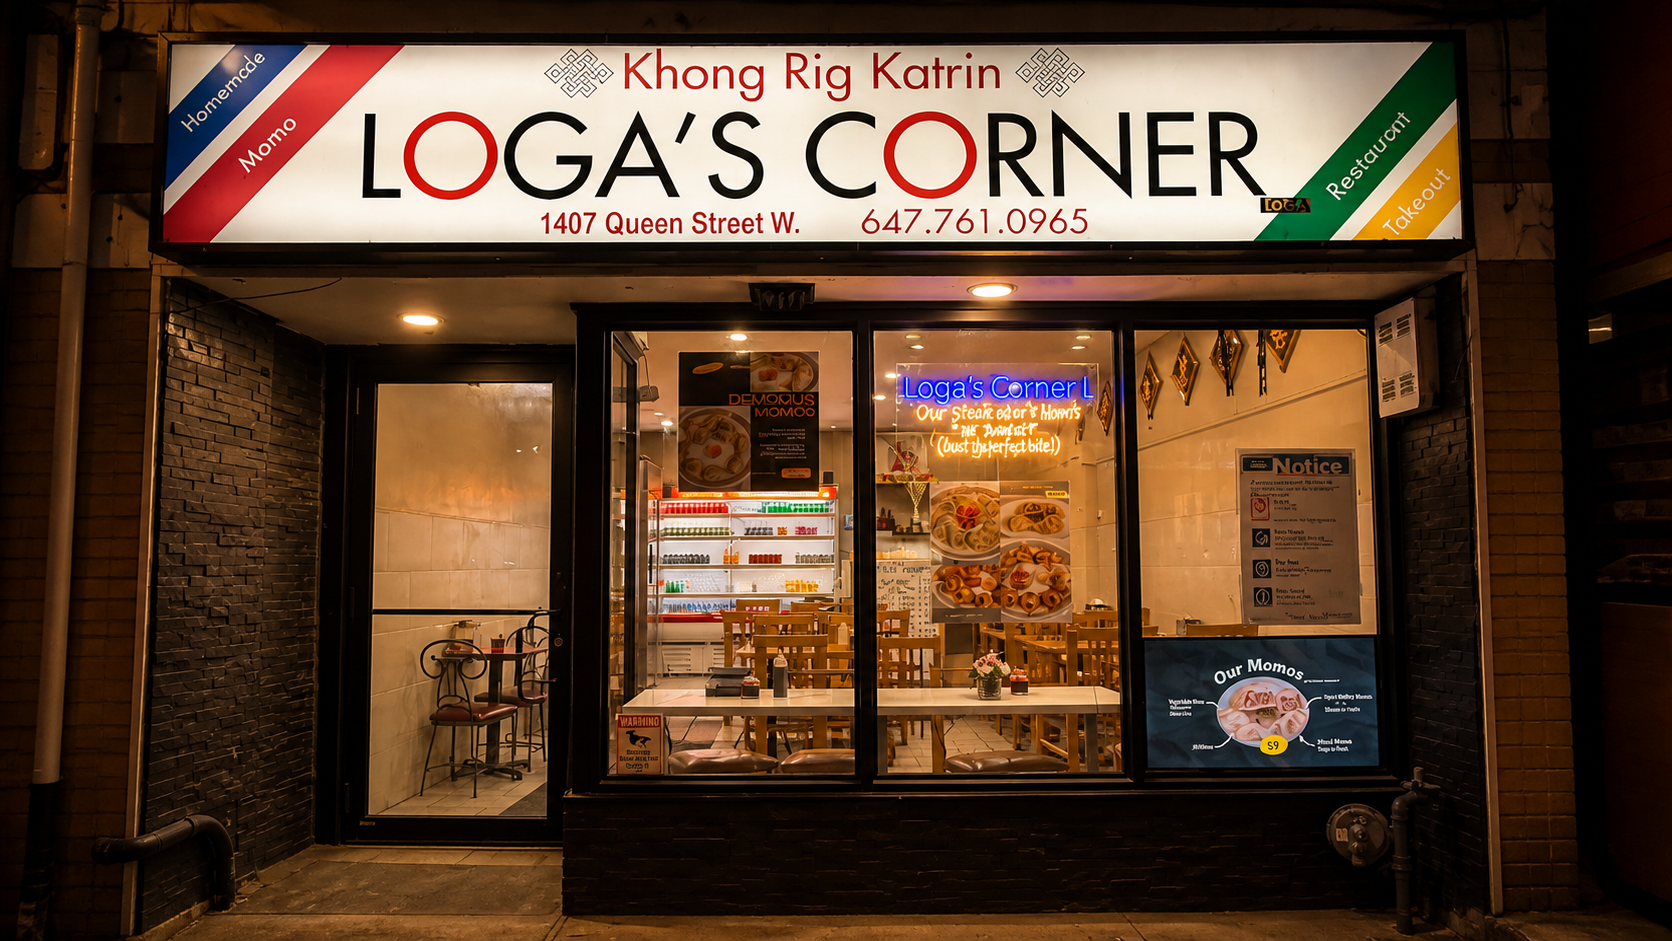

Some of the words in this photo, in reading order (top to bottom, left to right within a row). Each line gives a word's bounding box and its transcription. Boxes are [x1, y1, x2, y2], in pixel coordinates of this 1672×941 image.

[624, 49, 766, 103] Khong
[785, 52, 852, 102] Rig
[873, 52, 1002, 90] Katrin
[238, 118, 297, 173] Momo
[362, 109, 765, 201] LOGA'S
[805, 109, 1267, 201] CORNER
[1382, 168, 1451, 236] Takeout
[540, 211, 597, 235] 1407
[605, 211, 683, 236] Queen
[691, 211, 764, 235] Street
[770, 211, 800, 235] W.
[861, 207, 1090, 235] 647.761.0965
[903, 375, 984, 405] Loga's
[991, 375, 1077, 399] Corner
[916, 404, 948, 422] Our
[1273, 457, 1343, 475] Notice
[1213, 664, 1243, 685] Our
[1247, 658, 1305, 681] Momos
